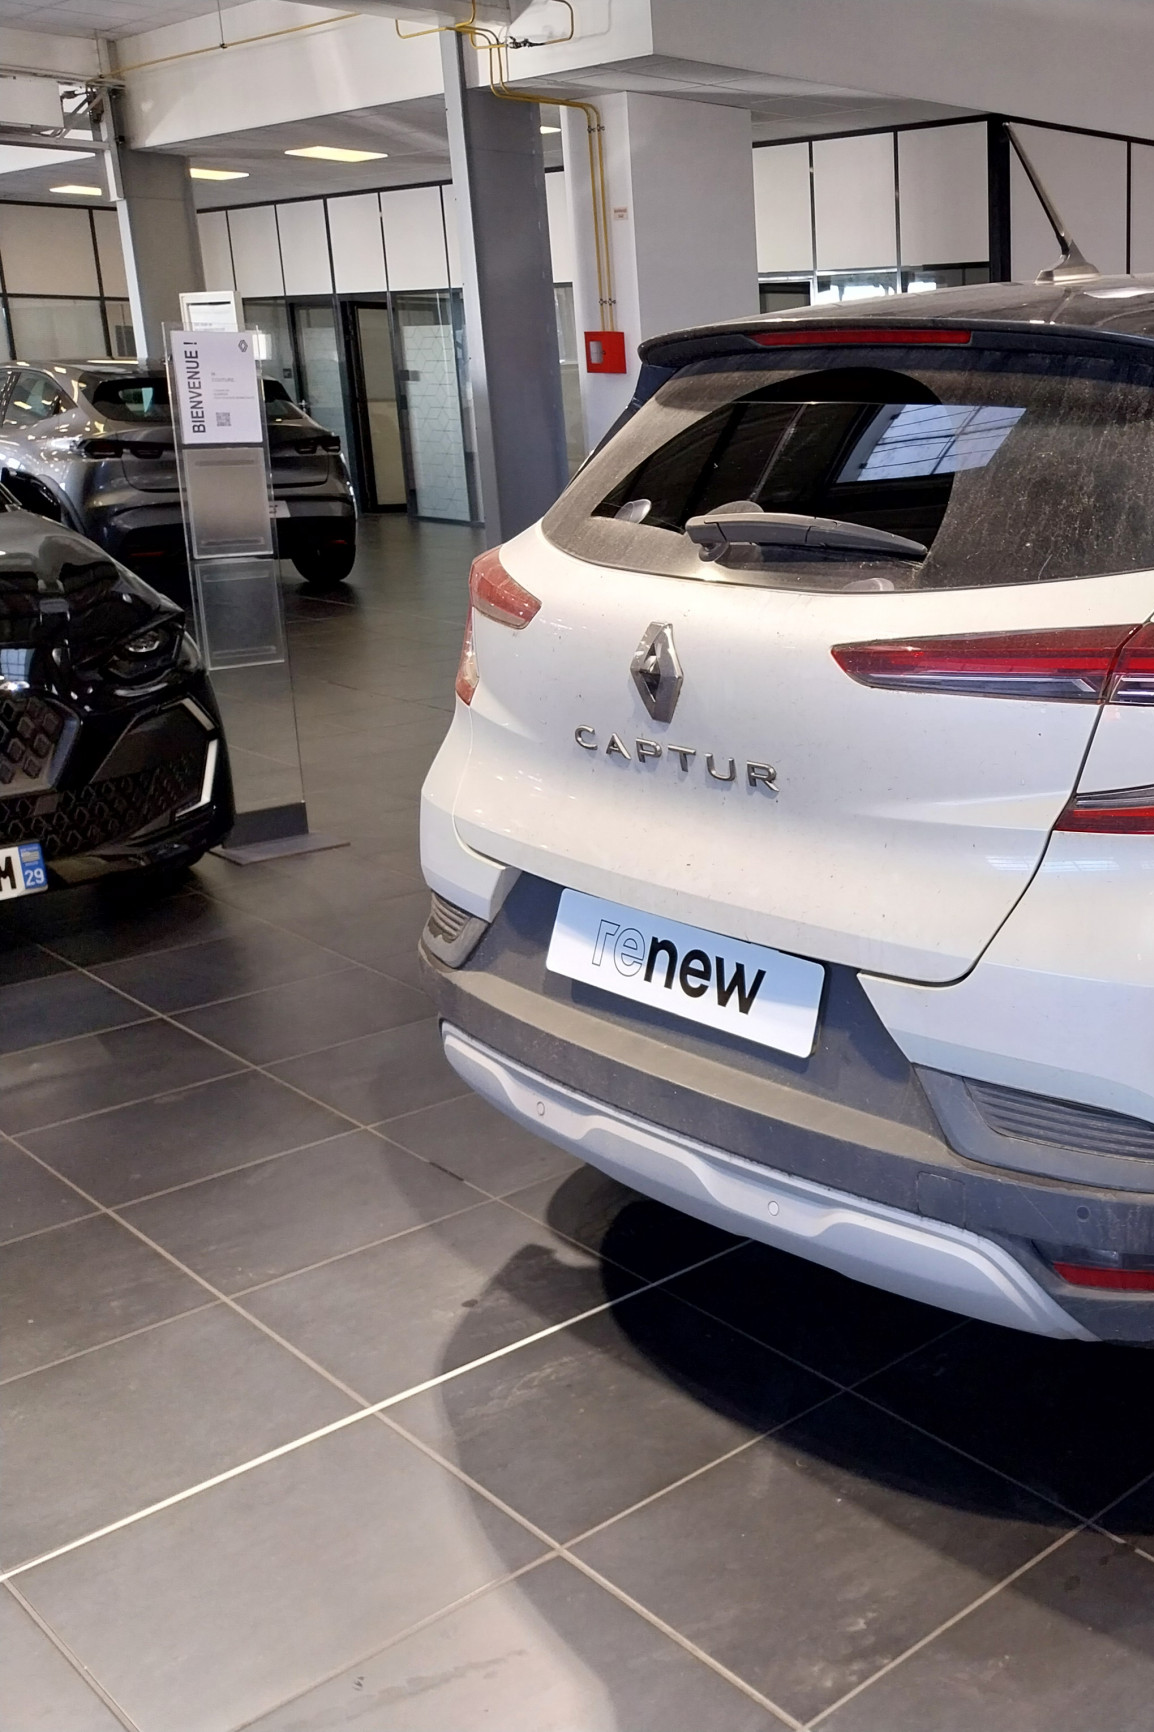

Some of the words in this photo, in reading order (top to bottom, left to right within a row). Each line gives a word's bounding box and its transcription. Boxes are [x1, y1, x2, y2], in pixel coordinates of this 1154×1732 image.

[184, 350, 206, 433] BIENVENUE
[575, 724, 779, 792] CAPTUR
[25, 868, 45, 886] 29
[592, 919, 767, 1015] renew
